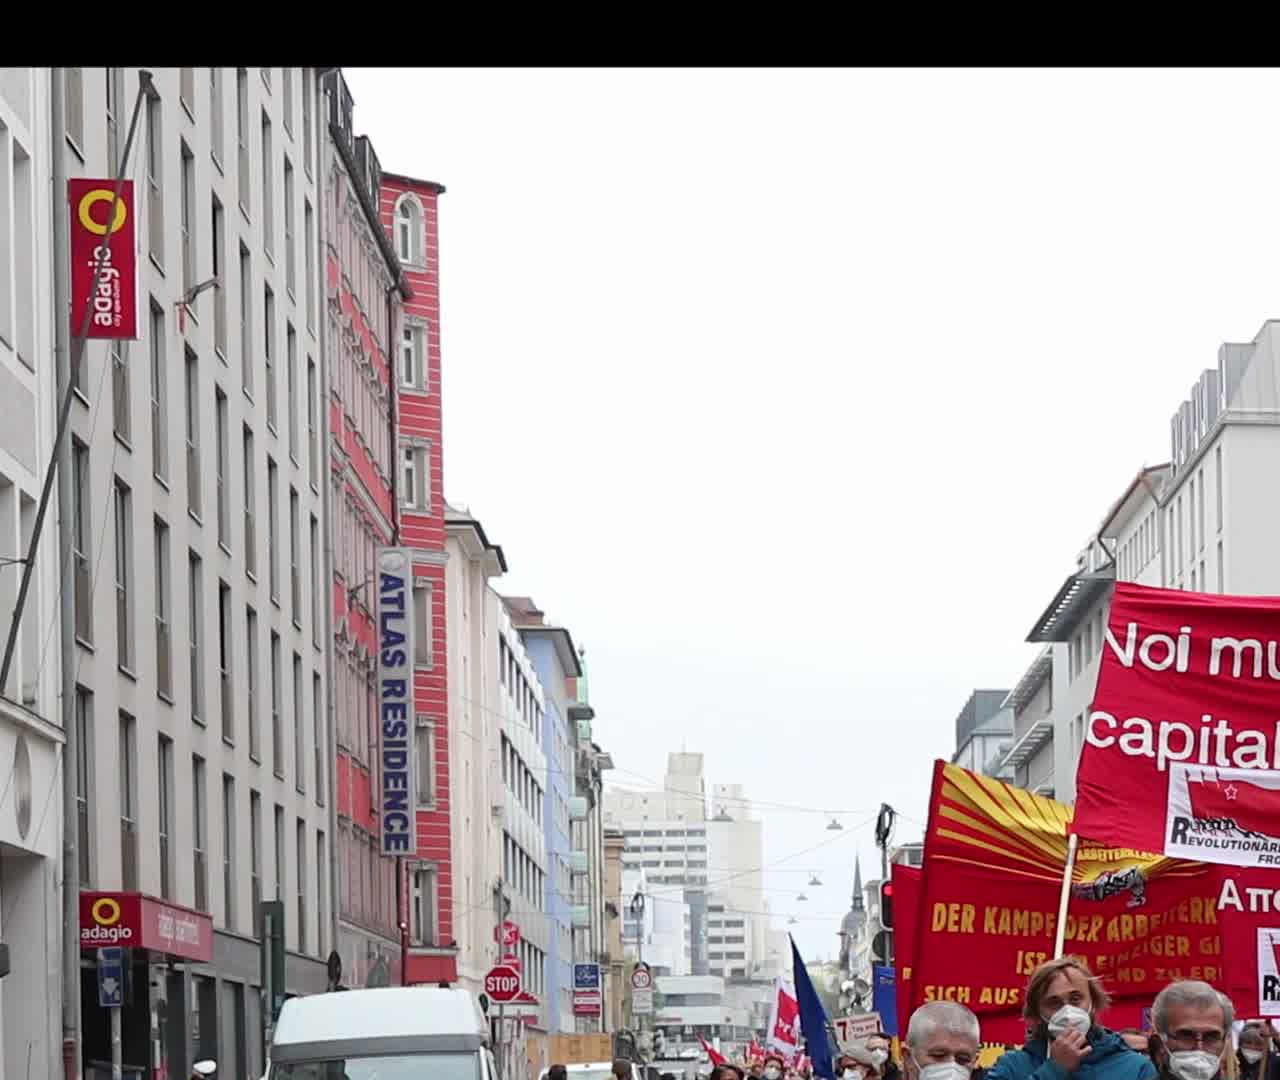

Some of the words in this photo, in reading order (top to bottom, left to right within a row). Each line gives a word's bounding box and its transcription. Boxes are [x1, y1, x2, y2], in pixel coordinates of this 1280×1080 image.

[379, 573, 407, 668] ATLAS
[1104, 622, 1192, 673] Noi
[381, 679, 409, 852] RESIDENCE
[81, 925, 132, 943] adagio
[932, 902, 976, 934] DER
[1063, 913, 1104, 943] DER
[486, 978, 518, 992] STOP
[924, 985, 971, 1003] SICH
[979, 986, 1020, 1005] AUS
